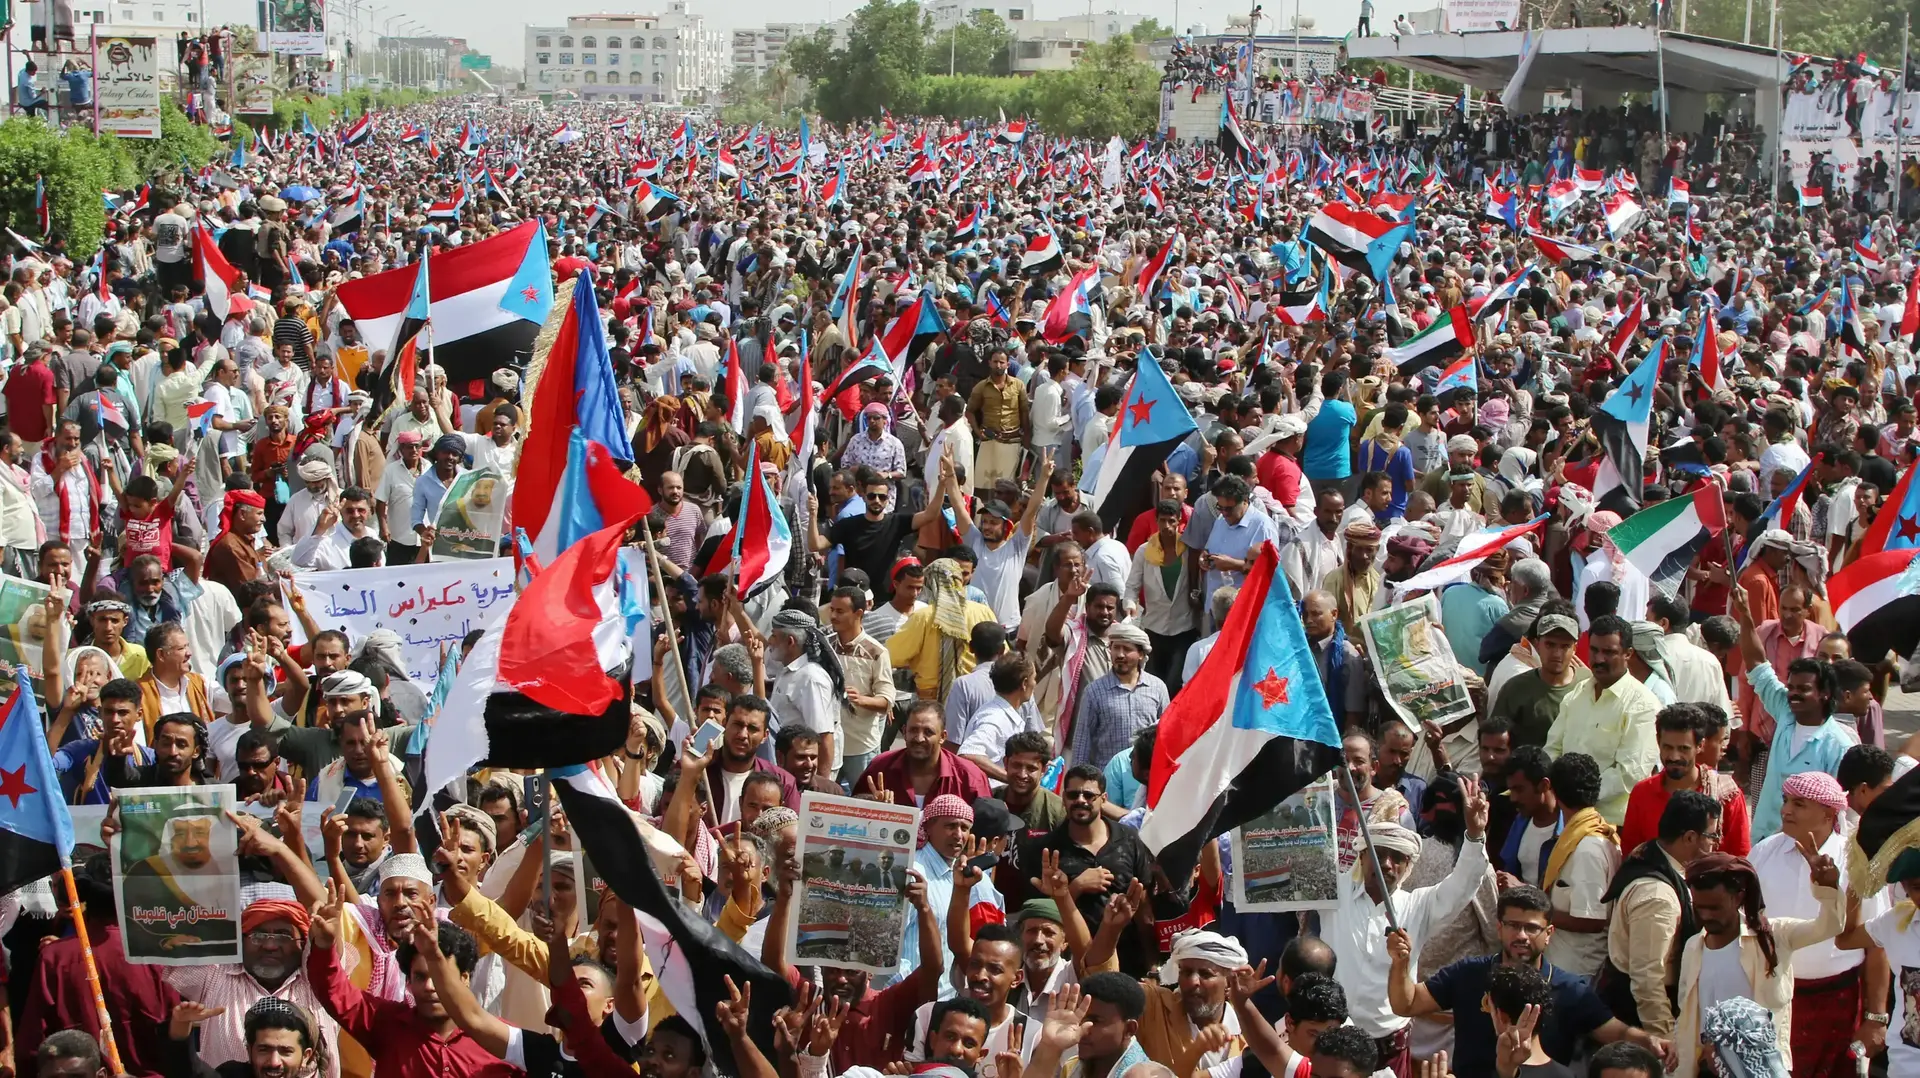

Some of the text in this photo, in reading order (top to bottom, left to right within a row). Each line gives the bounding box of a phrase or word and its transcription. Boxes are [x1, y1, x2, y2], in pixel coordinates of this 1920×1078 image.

[97, 72, 154, 86] جالاكسي كي
[126, 86, 154, 99] Cakes
[388, 580, 466, 618] مكيراس
[471, 582, 514, 608] يرية
[806, 877, 898, 896] شعب الجنوب فوضكم
[132, 905, 228, 930] سلمان في قلوبنا
